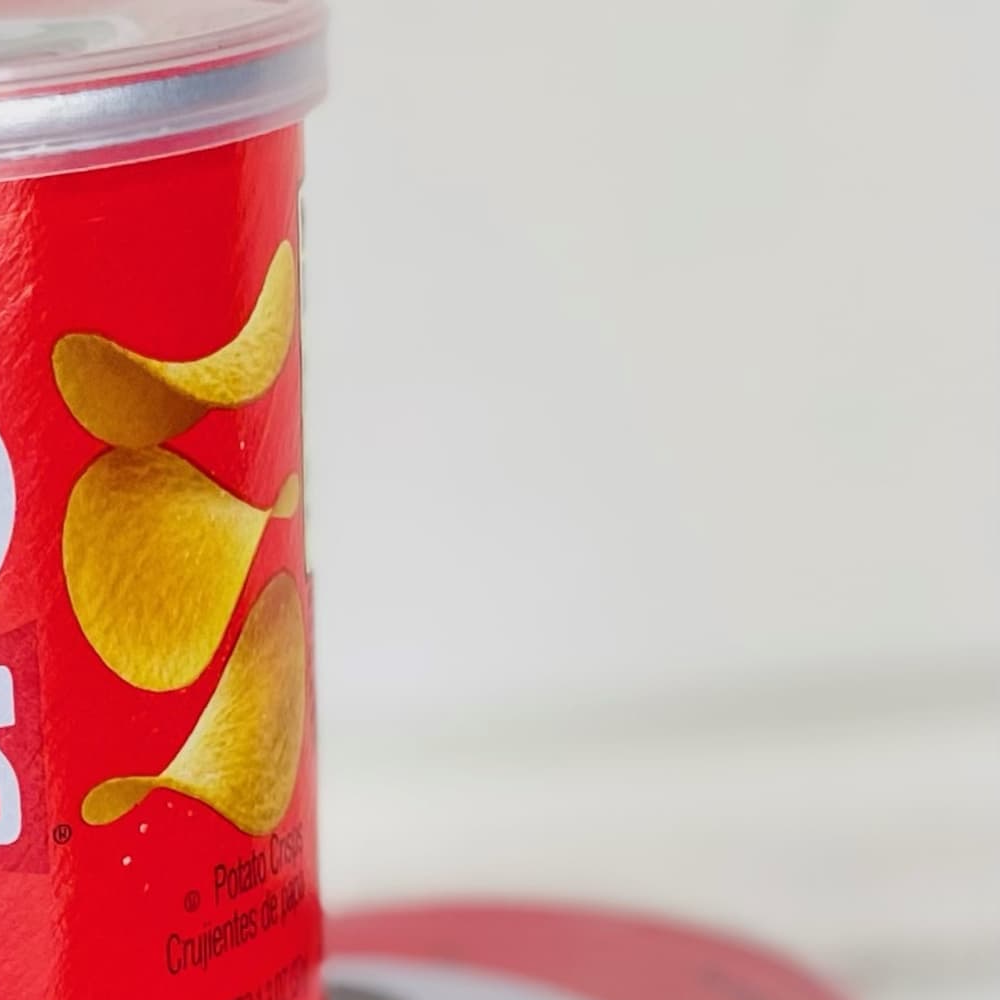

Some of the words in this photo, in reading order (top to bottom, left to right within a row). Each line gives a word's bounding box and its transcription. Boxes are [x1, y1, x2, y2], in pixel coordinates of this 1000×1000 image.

[213, 848, 266, 906] Potato
[166, 908, 257, 975] Crujientes
[261, 889, 278, 931] de
